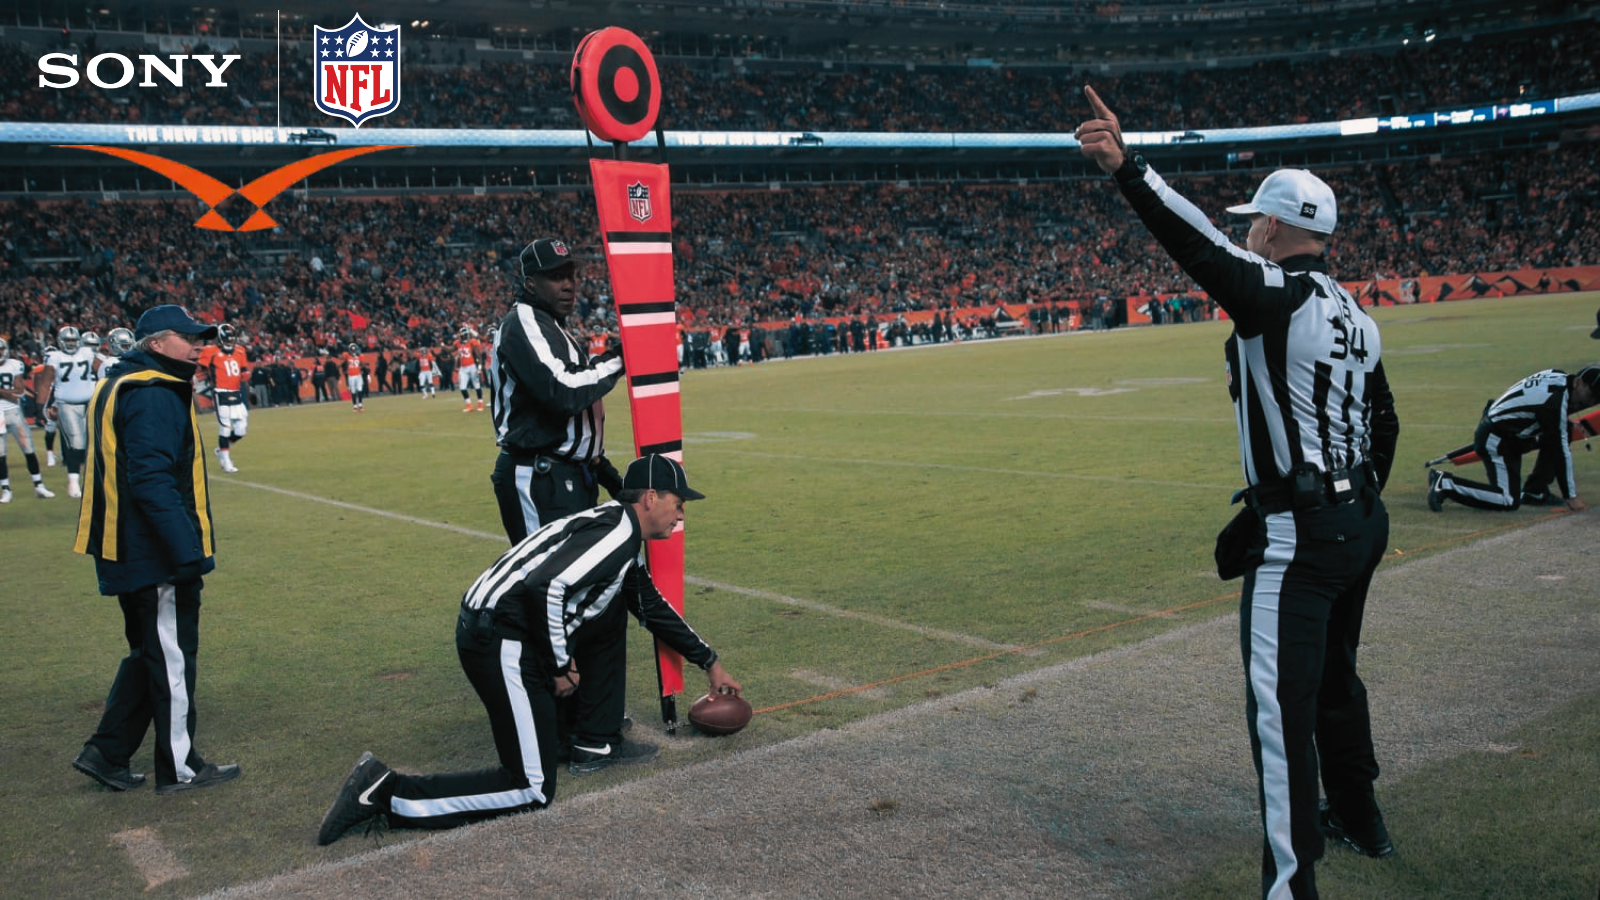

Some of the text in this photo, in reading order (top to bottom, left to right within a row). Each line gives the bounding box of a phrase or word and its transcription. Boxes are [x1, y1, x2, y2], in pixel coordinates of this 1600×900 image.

[125, 127, 158, 142] THE
[161, 127, 197, 142] NEW
[630, 199, 650, 218] NFL
[1327, 316, 1368, 364] 34
[59, 360, 89, 382] 77
[224, 360, 240, 376] 18
